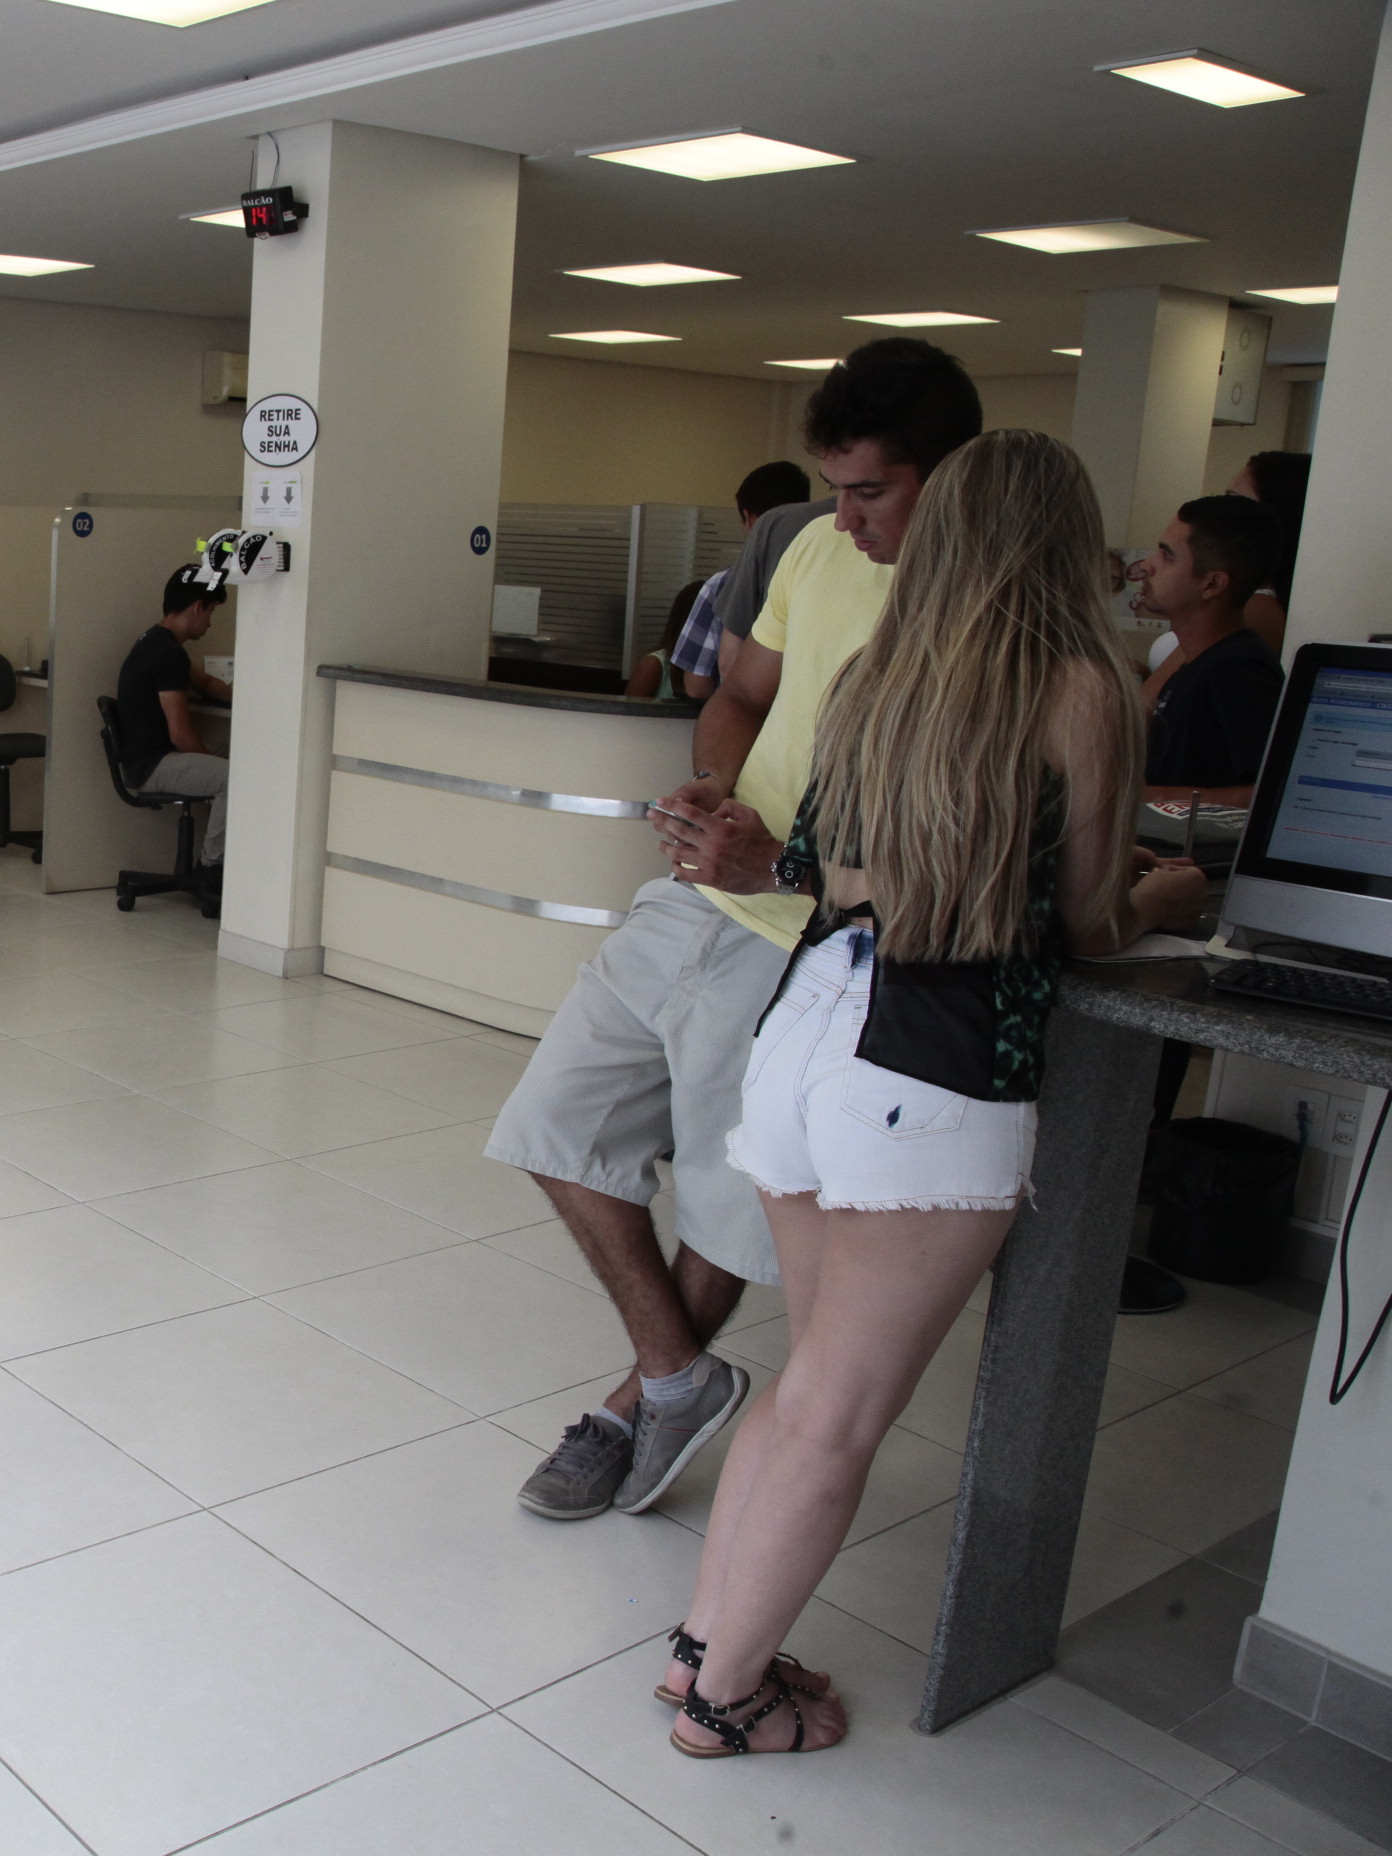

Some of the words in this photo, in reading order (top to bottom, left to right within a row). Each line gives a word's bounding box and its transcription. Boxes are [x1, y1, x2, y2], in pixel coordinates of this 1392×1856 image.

[242, 196, 273, 206] BALCÃO
[251, 207, 266, 225] 14
[260, 408, 302, 422] RETIRE
[267, 424, 290, 438] SUA
[259, 440, 298, 453] SENHA
[76, 519, 90, 531] 02
[473, 533, 488, 548] 01
